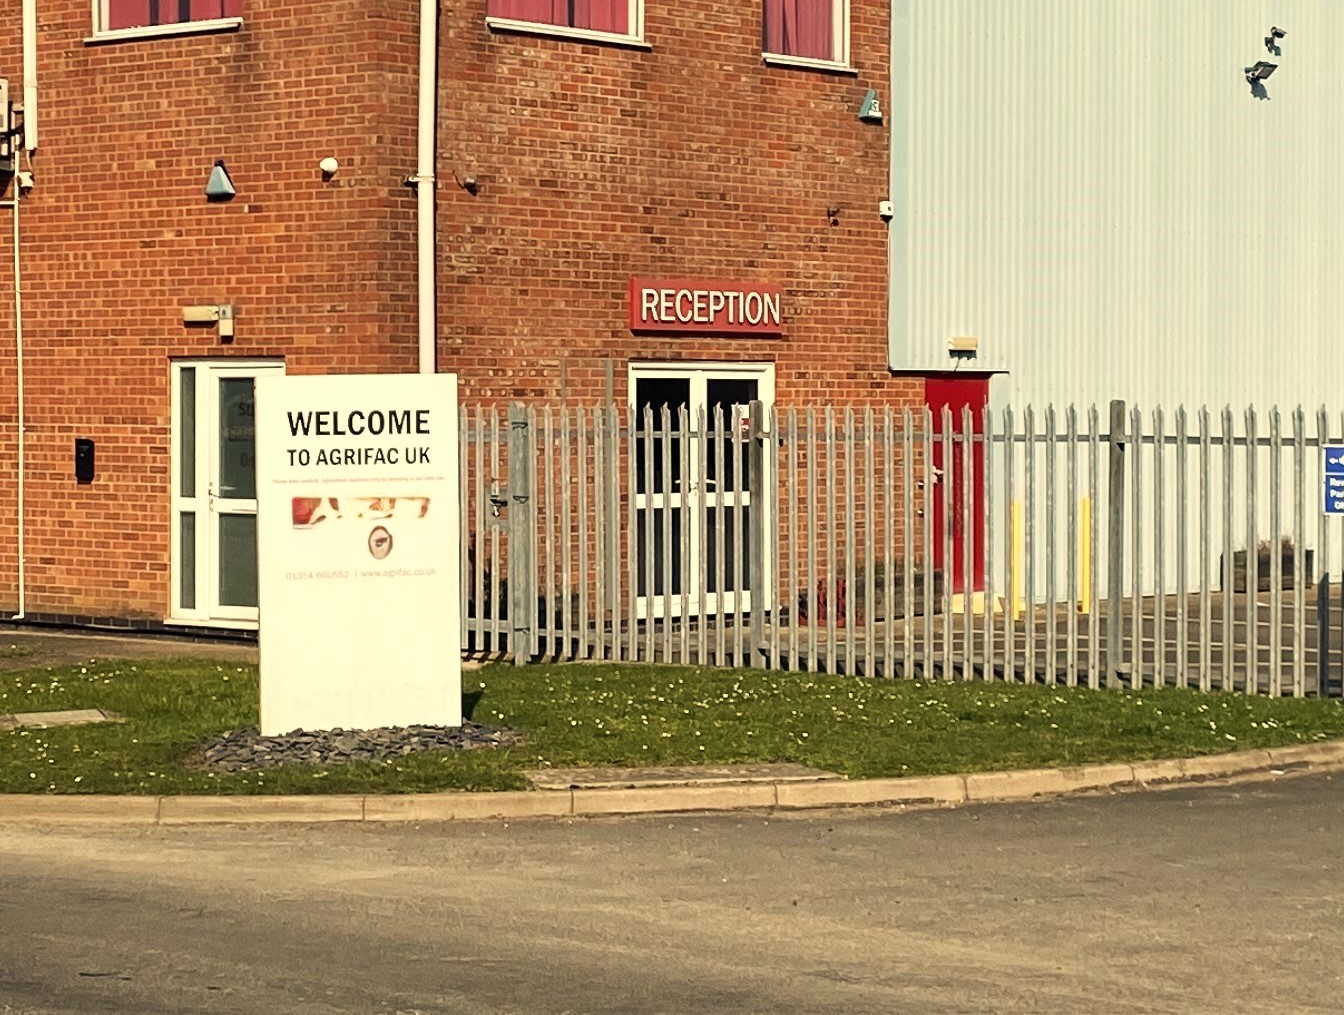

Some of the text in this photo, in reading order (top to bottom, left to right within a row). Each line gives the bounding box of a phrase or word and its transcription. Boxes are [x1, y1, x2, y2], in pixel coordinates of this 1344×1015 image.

[641, 287, 781, 325] RECEPTION
[287, 410, 431, 436] WELCOME
[287, 446, 431, 467] TO AGRIFAC UK
